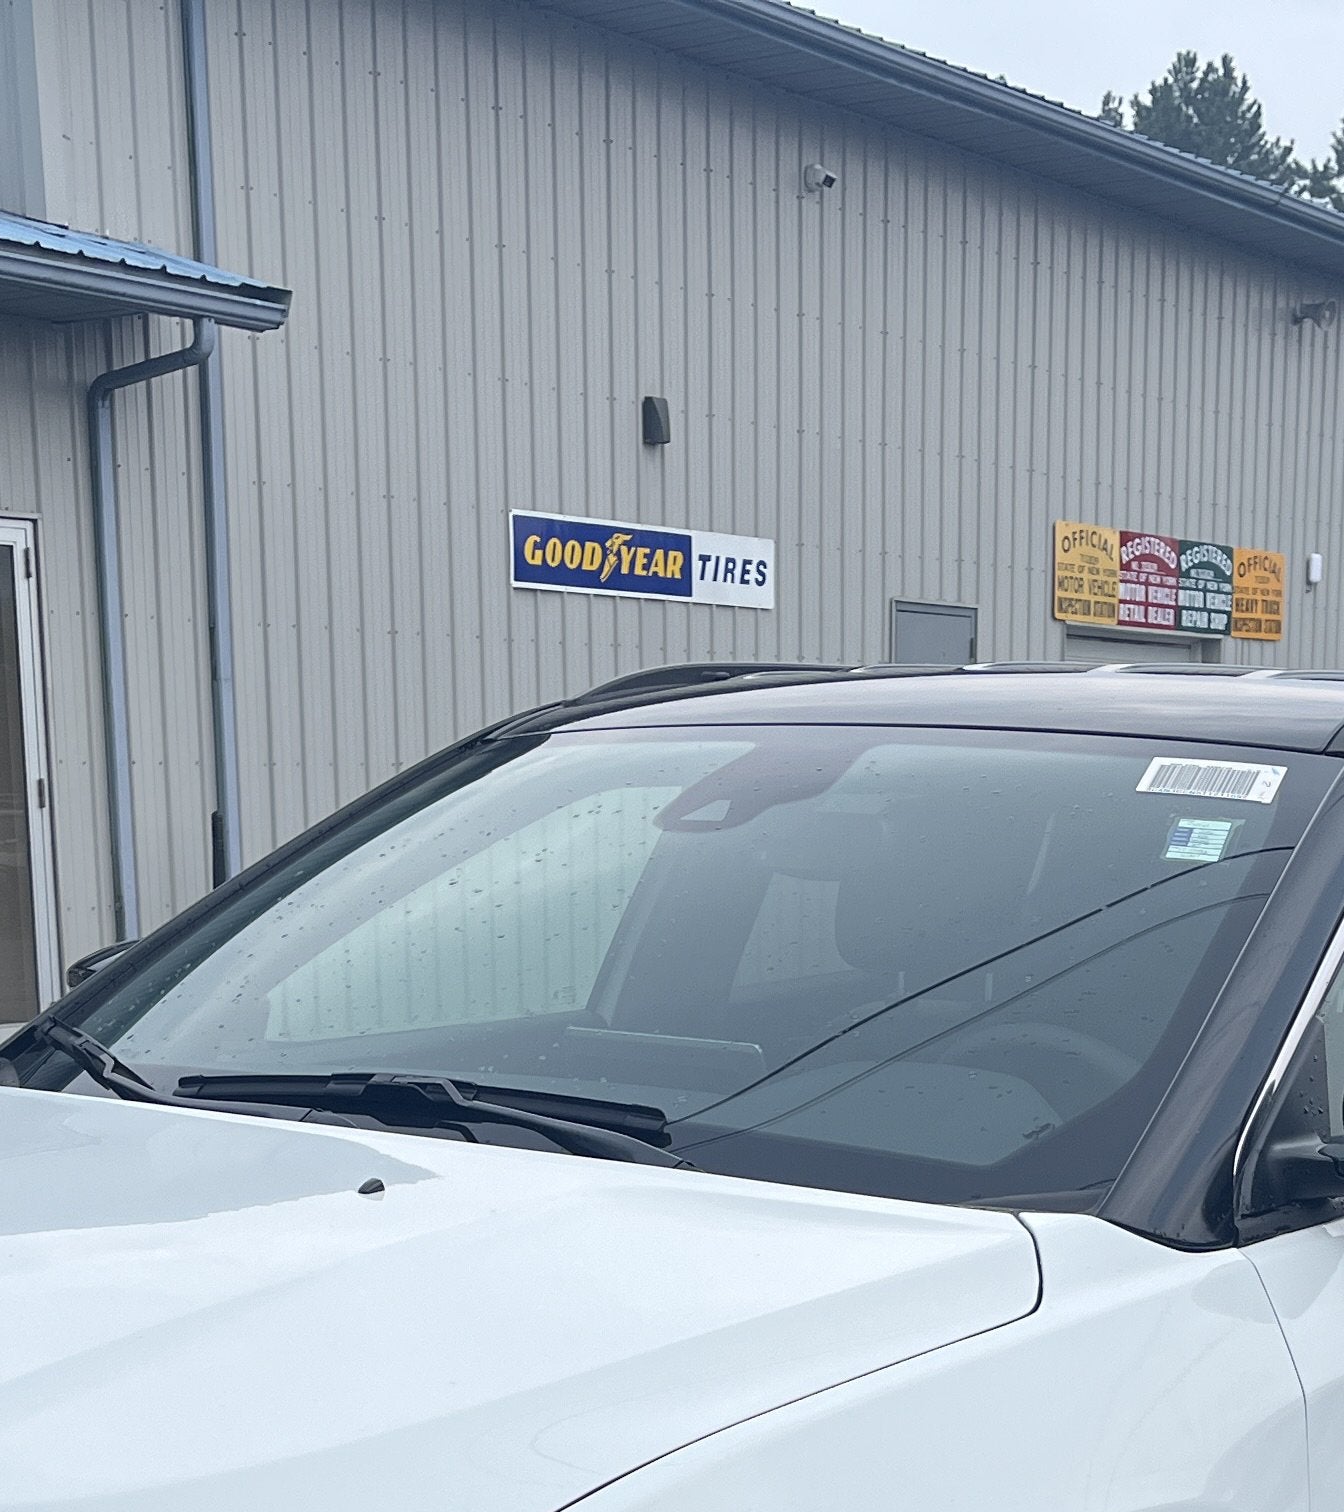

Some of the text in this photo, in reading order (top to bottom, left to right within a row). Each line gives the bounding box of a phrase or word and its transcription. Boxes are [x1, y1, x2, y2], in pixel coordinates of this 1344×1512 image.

[1061, 530, 1115, 562] OFFICIAL
[1120, 536, 1178, 569] REGISTERED
[1180, 544, 1233, 576] REGISTERED
[698, 553, 768, 587] TIRES
[1237, 555, 1281, 583] OFFICIAL
[1058, 575, 1117, 598] MOTOR VEHICLE
